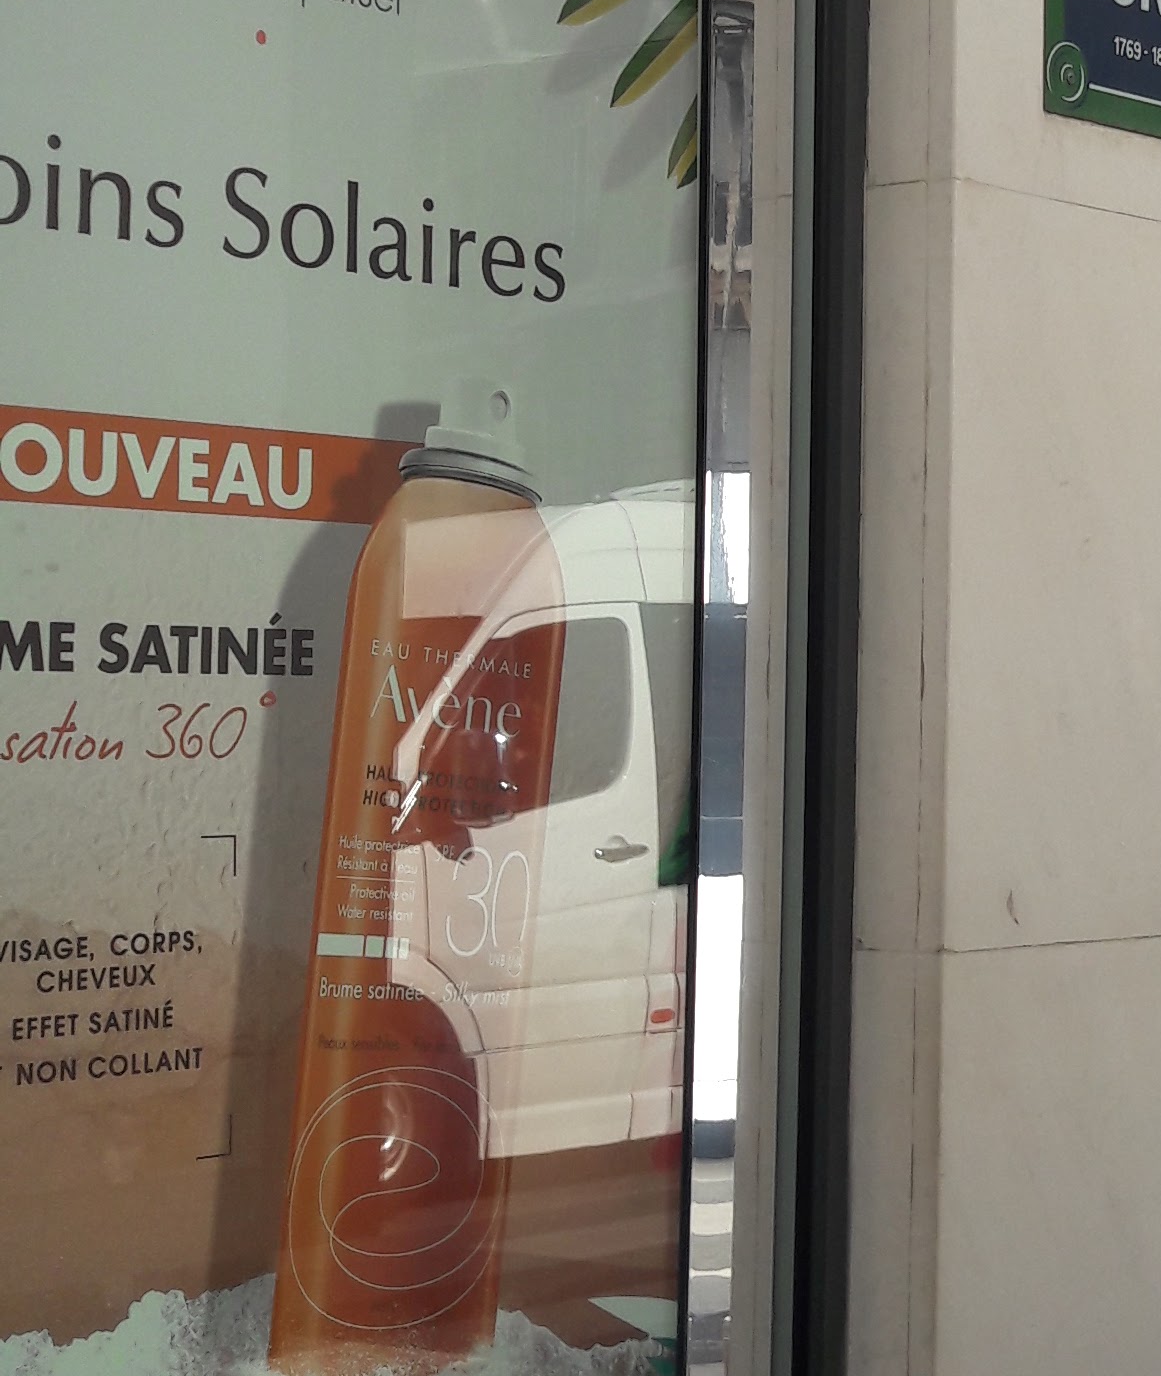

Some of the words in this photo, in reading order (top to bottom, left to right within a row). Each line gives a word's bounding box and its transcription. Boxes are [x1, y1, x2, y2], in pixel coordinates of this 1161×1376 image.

[222, 167, 566, 303] Solaires
[0, 422, 314, 510] OUVEAU
[98, 612, 314, 676] SATINÉE
[371, 639, 410, 660] EAU
[424, 646, 532, 680] THERMALE
[370, 664, 522, 739] Avène
[339, 835, 363, 851] Huile
[337, 904, 366, 919] Water
[350, 884, 399, 901] Protective
[446, 846, 530, 957] 30
[110, 930, 202, 955] CORPS,
[36, 964, 156, 993] CHEVEUX
[319, 977, 363, 998] Brume
[367, 982, 424, 1001] satinée
[12, 1013, 79, 1041] EFFET
[88, 999, 174, 1035] SATINÉ
[16, 1059, 77, 1085] NON
[88, 1048, 203, 1079] COLLANT
